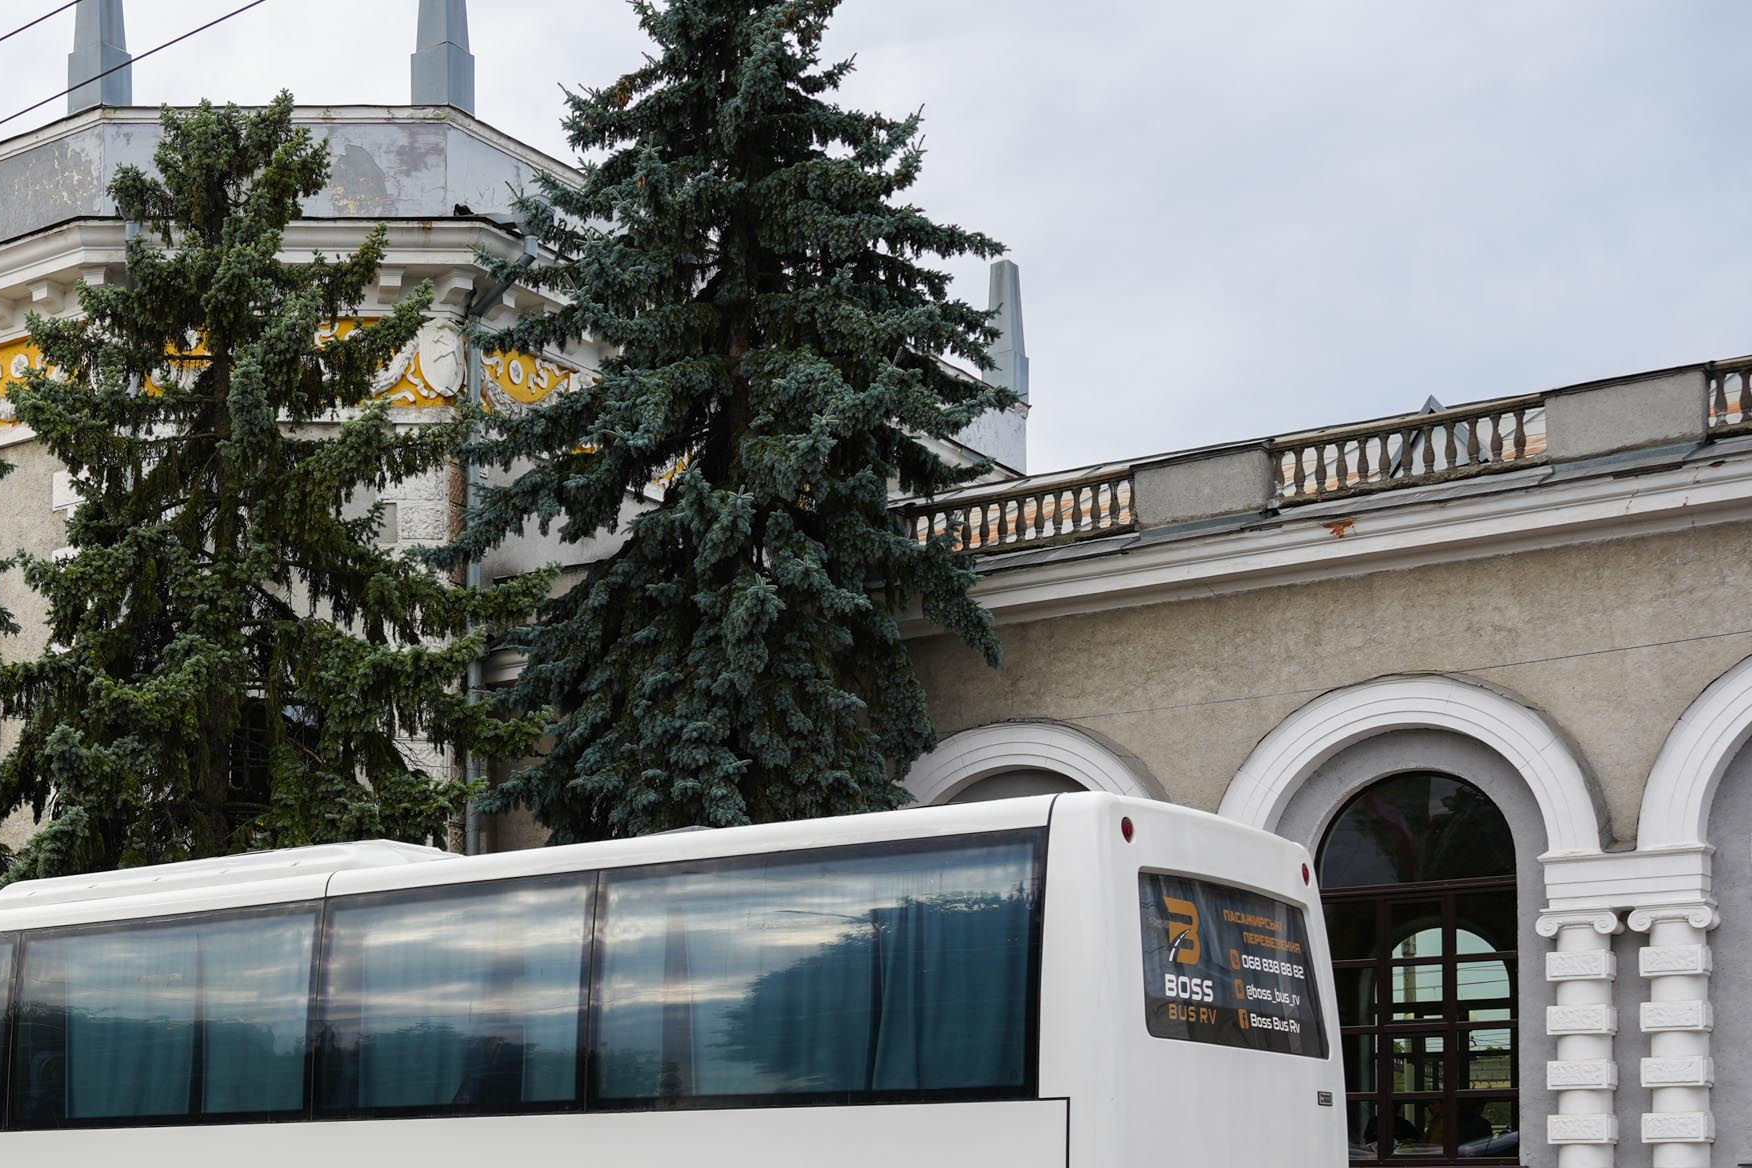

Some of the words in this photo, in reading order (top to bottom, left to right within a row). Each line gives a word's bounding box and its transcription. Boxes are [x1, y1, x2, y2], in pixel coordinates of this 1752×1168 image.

[1242, 931, 1301, 954] ПЕРЕВЕЗЕННЯ
[1241, 954, 1262, 970] 068
[1262, 958, 1280, 974] 838
[1280, 962, 1293, 976] 88
[1293, 965, 1304, 979] 82
[1165, 973, 1213, 1002] BOSS
[1246, 984, 1300, 1007] @boss_bus_rv
[1168, 1003, 1196, 1022] BUS
[1200, 1007, 1217, 1025] RV
[1250, 1013, 1272, 1029] Boss
[1272, 1017, 1289, 1032] Bus
[1289, 1019, 1300, 1034] Rv
